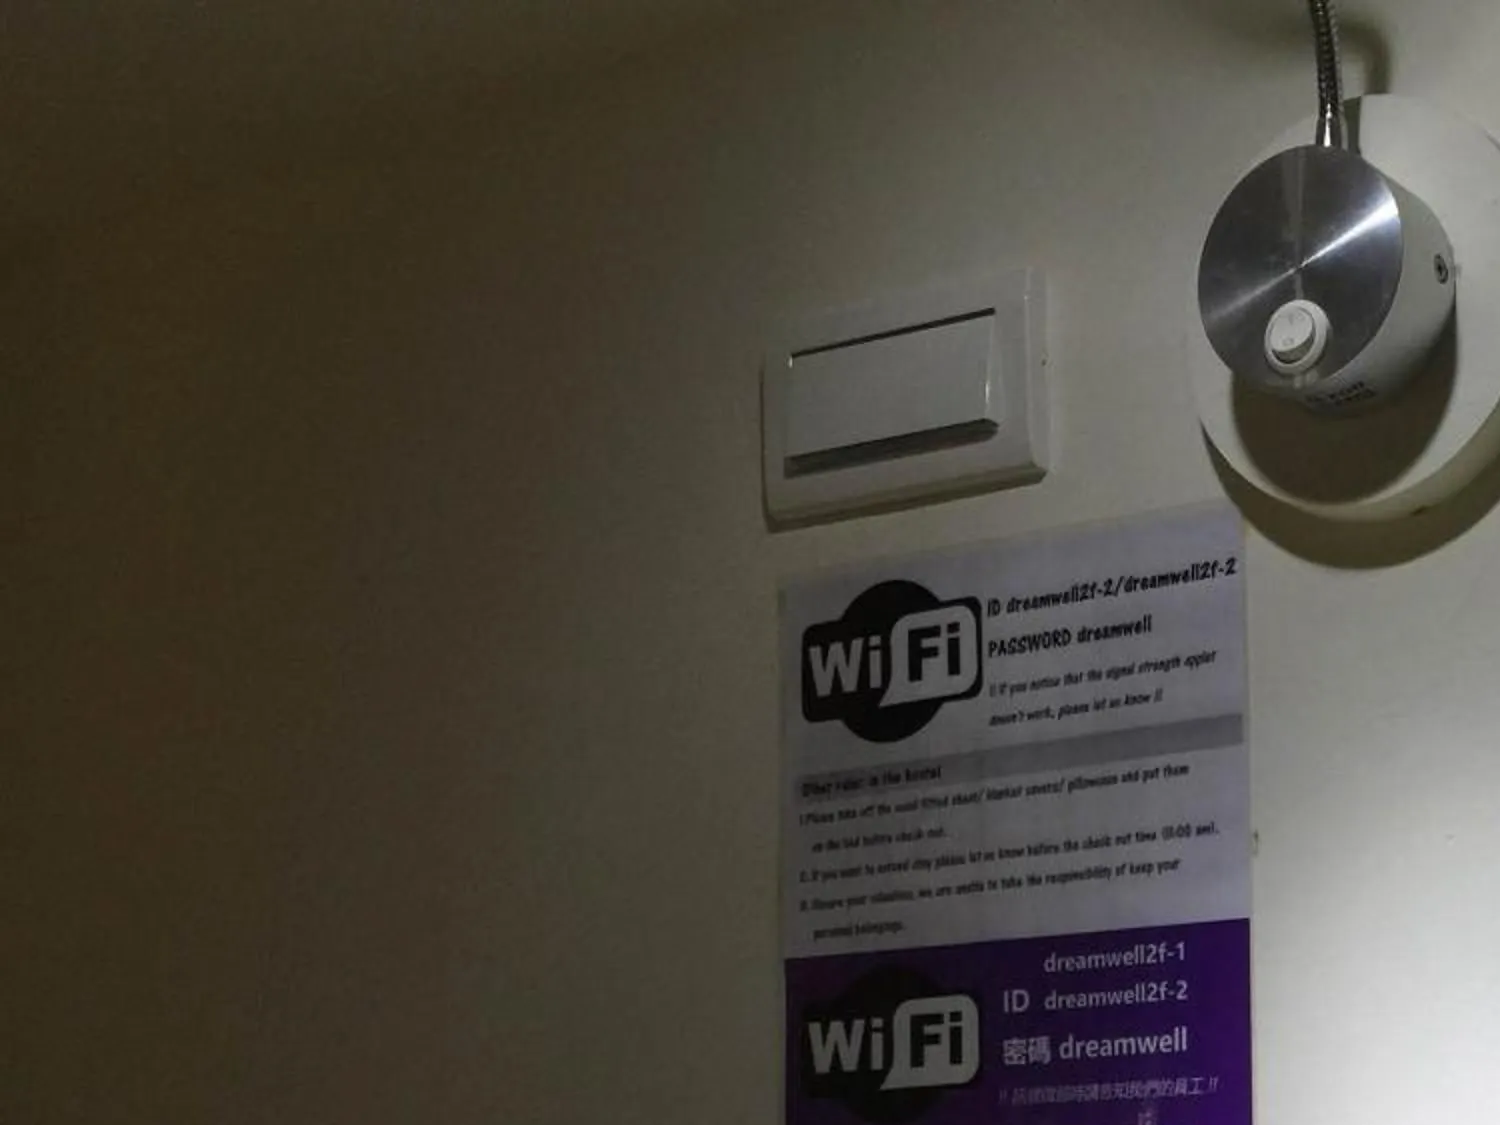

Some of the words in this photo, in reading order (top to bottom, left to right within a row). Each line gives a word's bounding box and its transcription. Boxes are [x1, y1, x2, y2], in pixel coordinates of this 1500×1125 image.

[987, 599, 1001, 616] ID
[1006, 556, 1238, 614] dreamwell2f-2/dreamwell2f-2
[988, 628, 1072, 658] PASSWORD
[1077, 613, 1153, 644] dreamwell
[1064, 671, 1083, 687] that
[1087, 667, 1103, 682] the
[1138, 655, 1181, 674] strength
[1058, 702, 1090, 720] please
[1124, 693, 1150, 707] know
[1121, 768, 1139, 783] and
[1142, 766, 1160, 783] put
[1163, 764, 1190, 778] them
[1027, 842, 1061, 857] before
[1063, 839, 1080, 852] the
[1082, 835, 1112, 850] check
[1115, 833, 1132, 847] out
[1135, 831, 1157, 843] time
[1026, 874, 1043, 887] the
[1115, 863, 1127, 877] of
[1129, 861, 1155, 876] keep
[1157, 858, 1182, 876] your
[1043, 941, 1185, 973] dreamwell2f-1
[1003, 989, 1029, 1013] ID
[1044, 980, 1188, 1010] dreamwell2f-2
[808, 1010, 962, 1074] WiFi
[1003, 1036, 1051, 1065] 密碼
[1058, 1025, 1188, 1059] dreamwell
